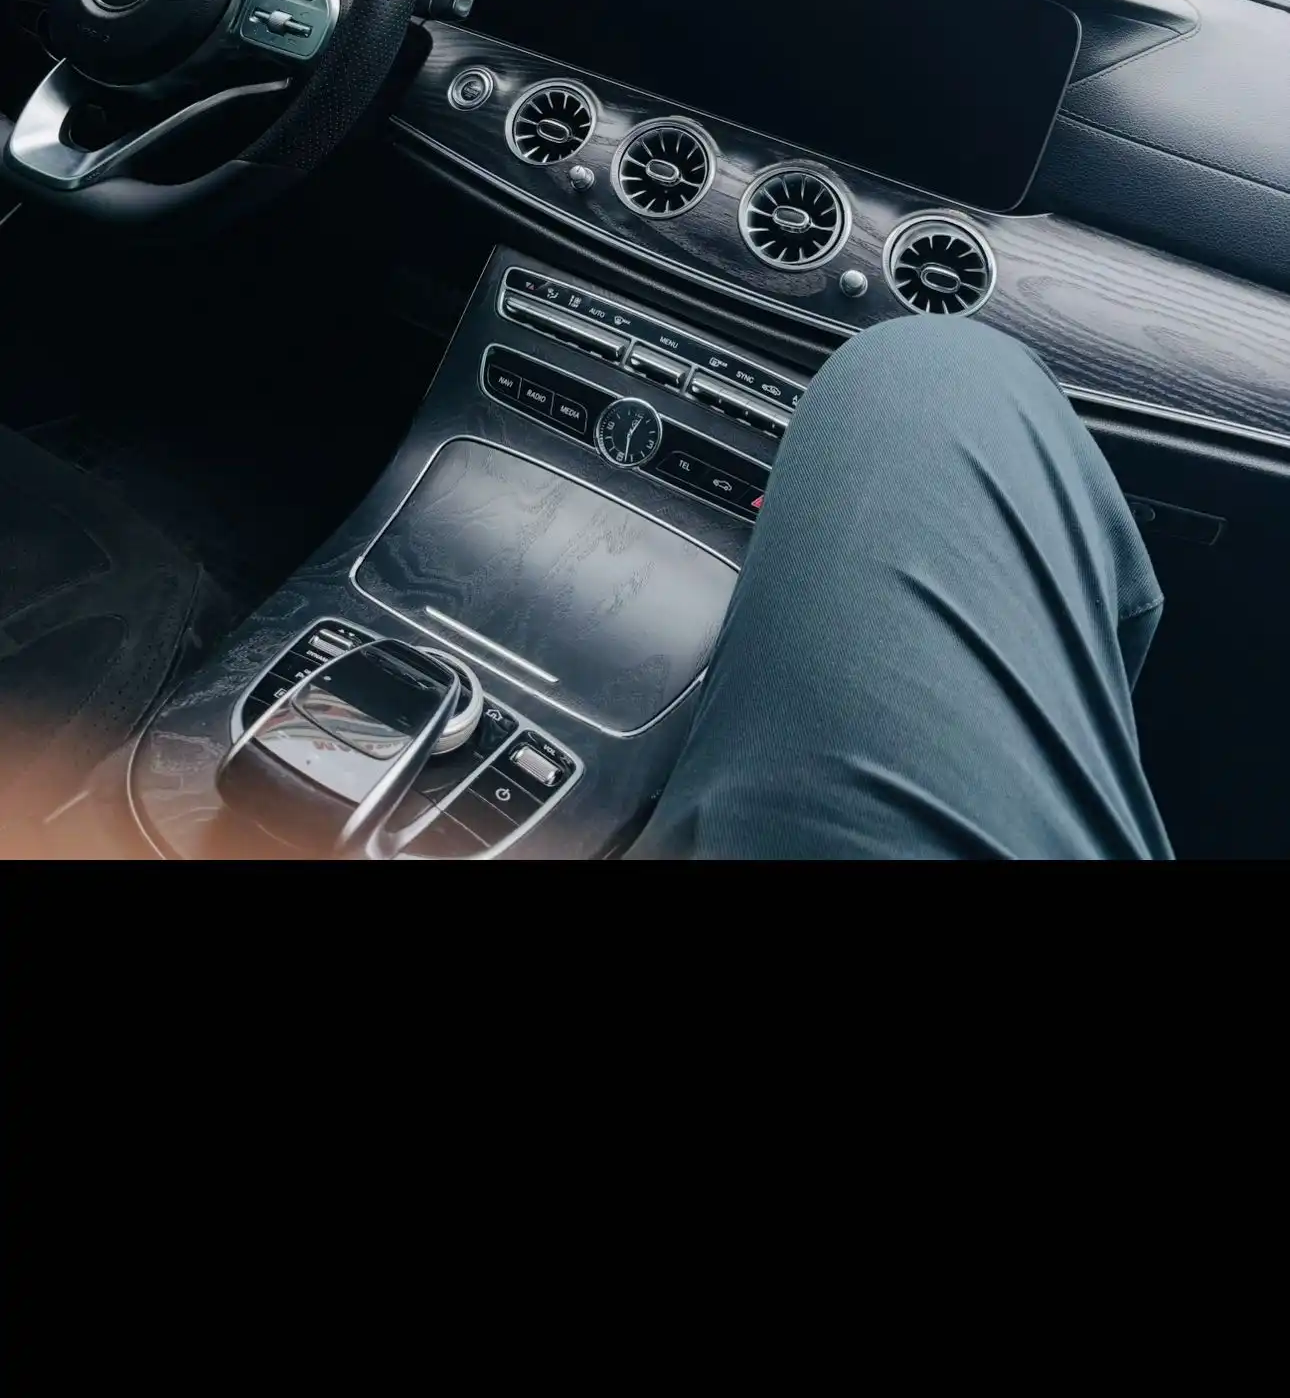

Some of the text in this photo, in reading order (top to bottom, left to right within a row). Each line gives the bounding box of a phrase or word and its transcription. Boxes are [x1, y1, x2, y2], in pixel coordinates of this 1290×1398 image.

[588, 307, 606, 319] AUTO
[659, 335, 679, 349] MENU
[498, 376, 514, 388] NAVI
[735, 370, 755, 384] SYNC
[526, 389, 547, 403] RADIO
[559, 405, 580, 419] MEDIA
[678, 459, 692, 472] TEL
[543, 744, 556, 756] VOL
